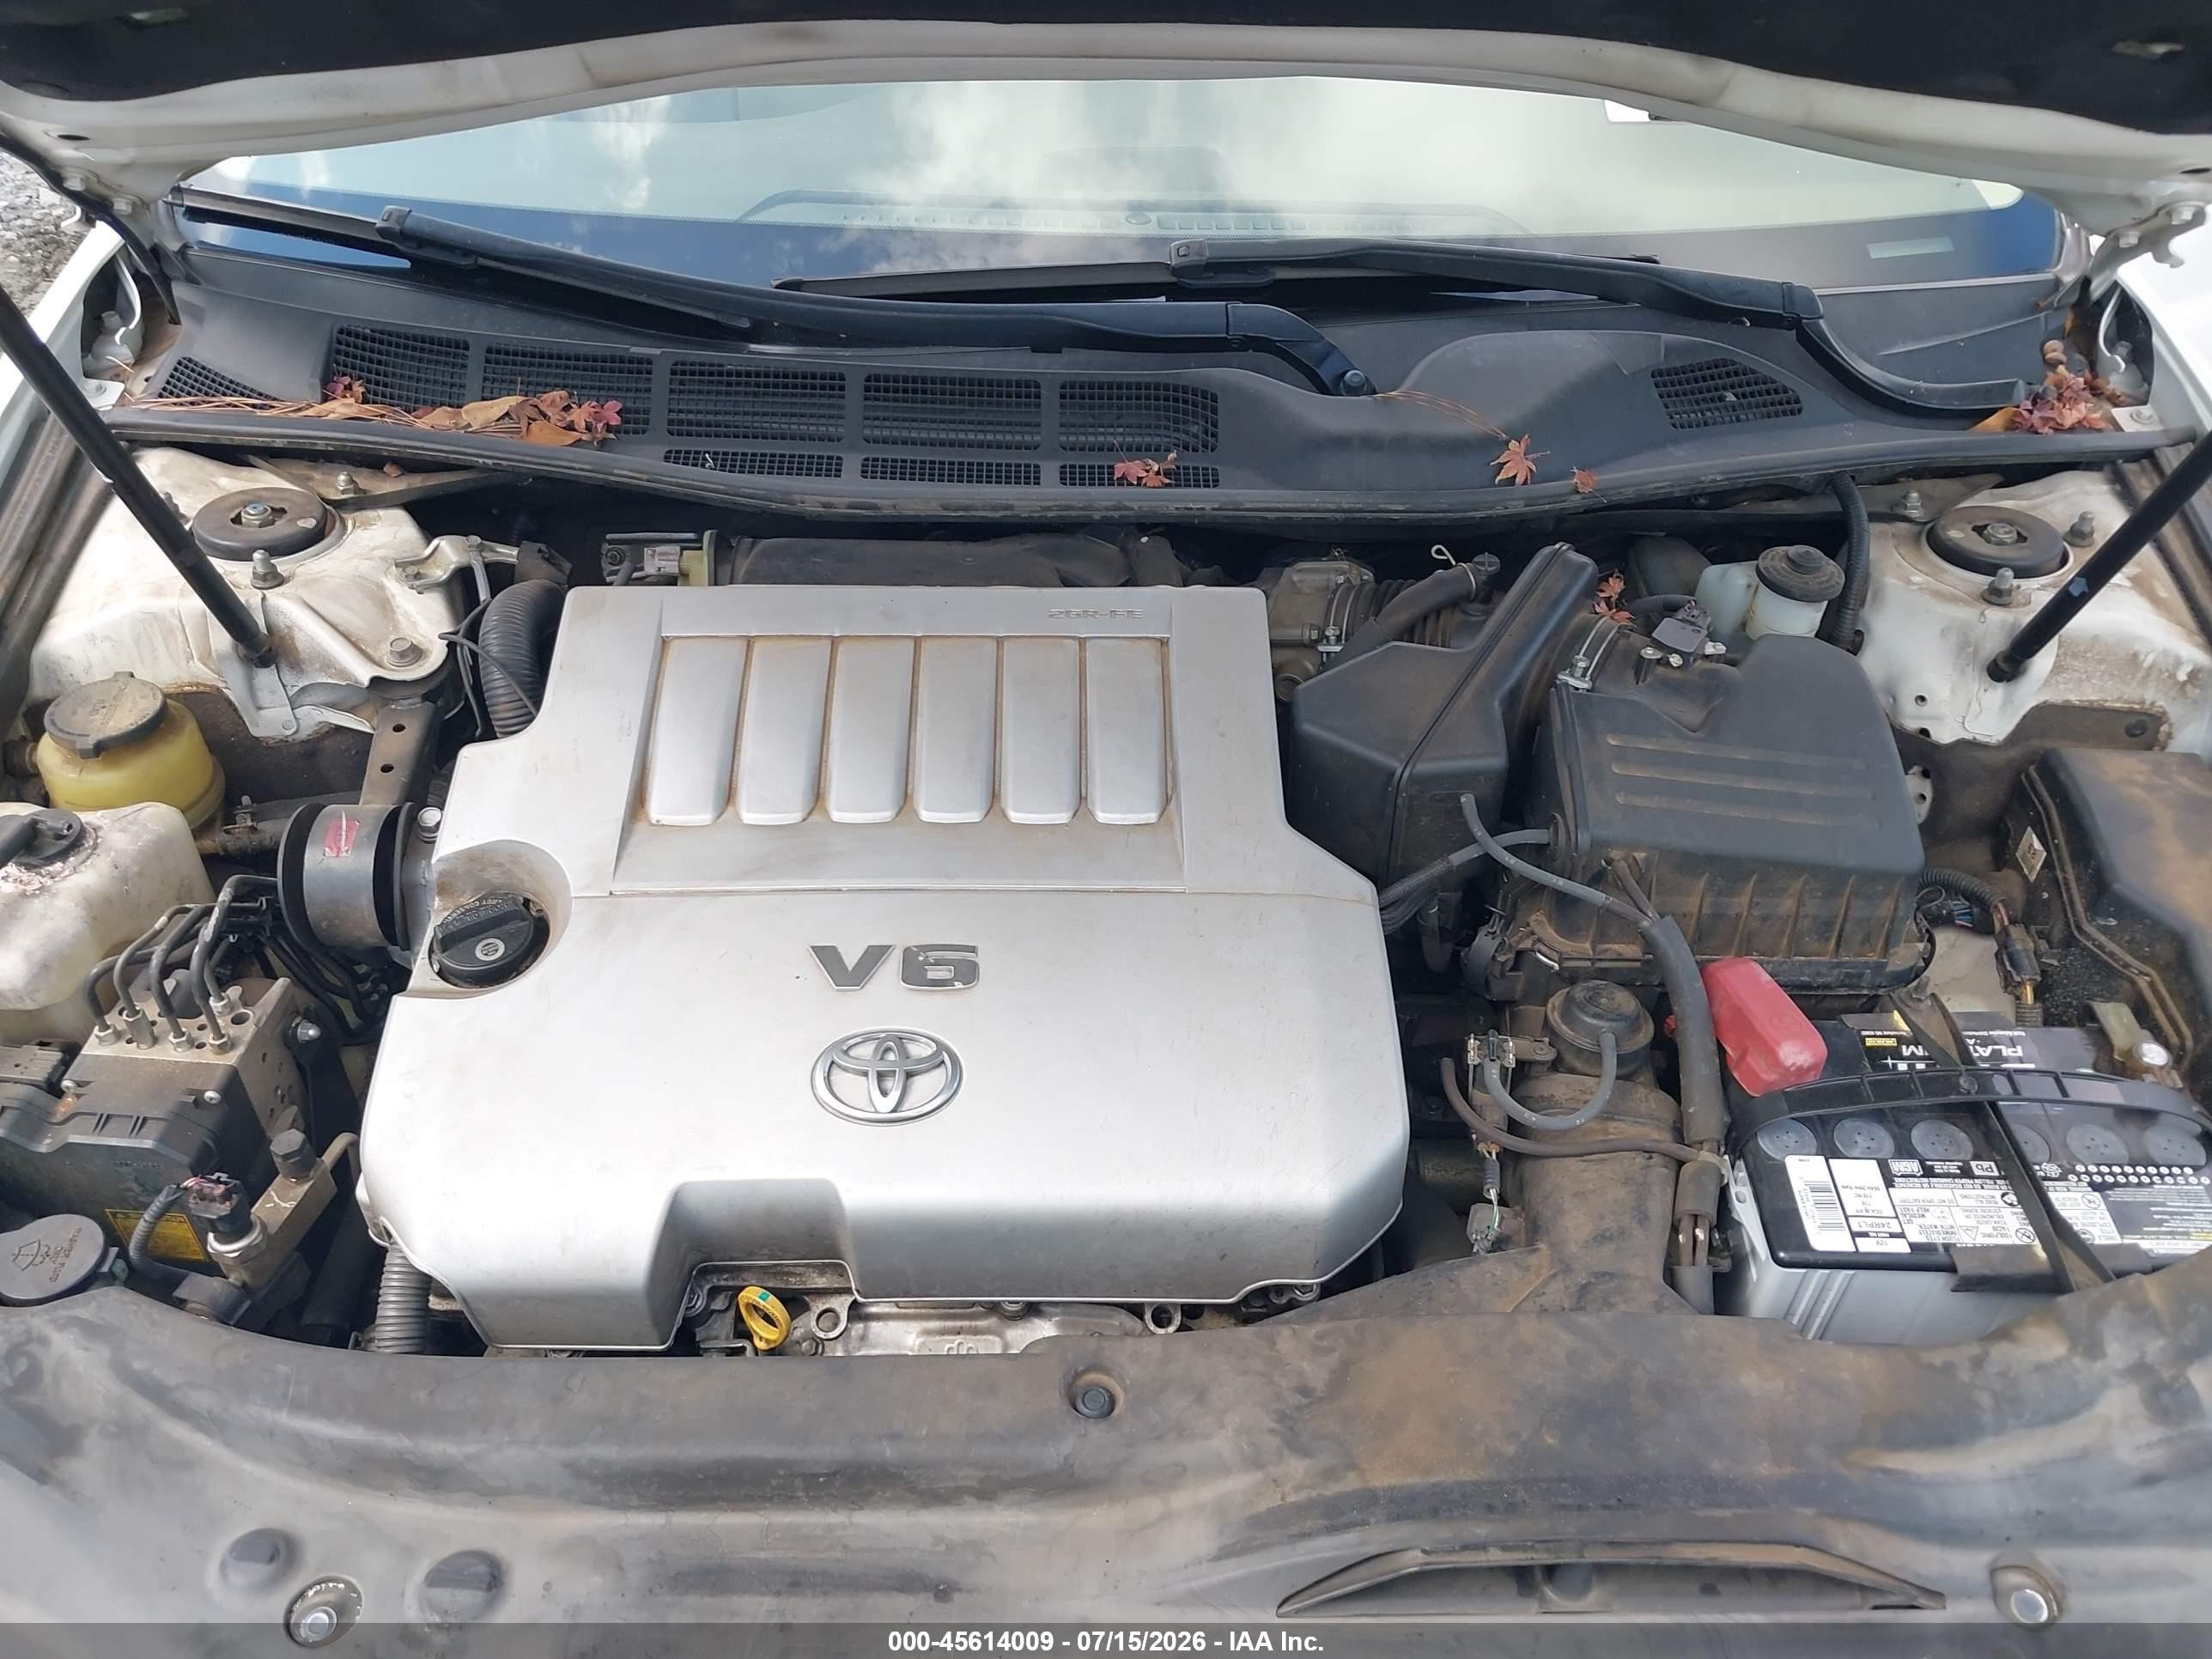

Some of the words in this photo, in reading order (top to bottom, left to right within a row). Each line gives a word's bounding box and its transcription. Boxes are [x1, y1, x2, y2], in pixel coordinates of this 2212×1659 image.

[1048, 608, 1144, 618] 2GR-FE
[807, 944, 981, 993] V6
[1891, 1161, 1918, 1173] AGM
[1975, 1164, 1994, 1172] Pb
